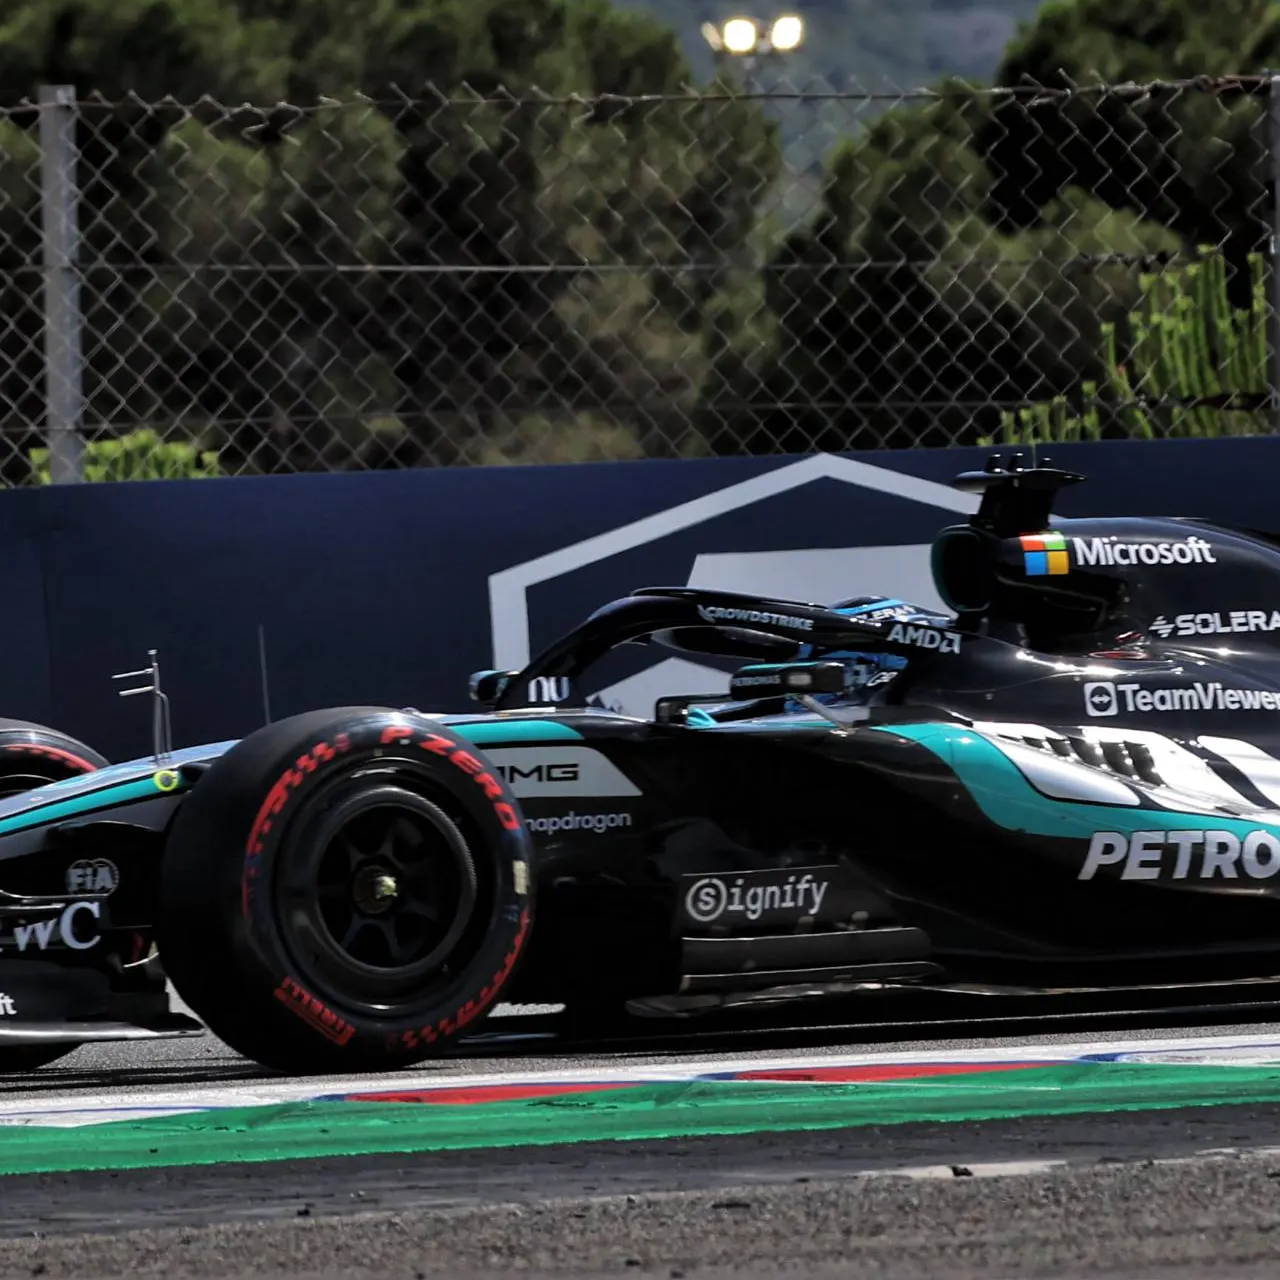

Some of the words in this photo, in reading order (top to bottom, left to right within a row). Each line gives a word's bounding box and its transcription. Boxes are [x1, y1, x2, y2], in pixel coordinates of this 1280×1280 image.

[1072, 536, 1217, 566] Microsoft
[705, 606, 815, 631] CROWDSTRIKE
[887, 623, 942, 650] AMD
[528, 675, 570, 703] nu
[420, 733, 519, 831] ZERO
[523, 810, 633, 836] napdragon
